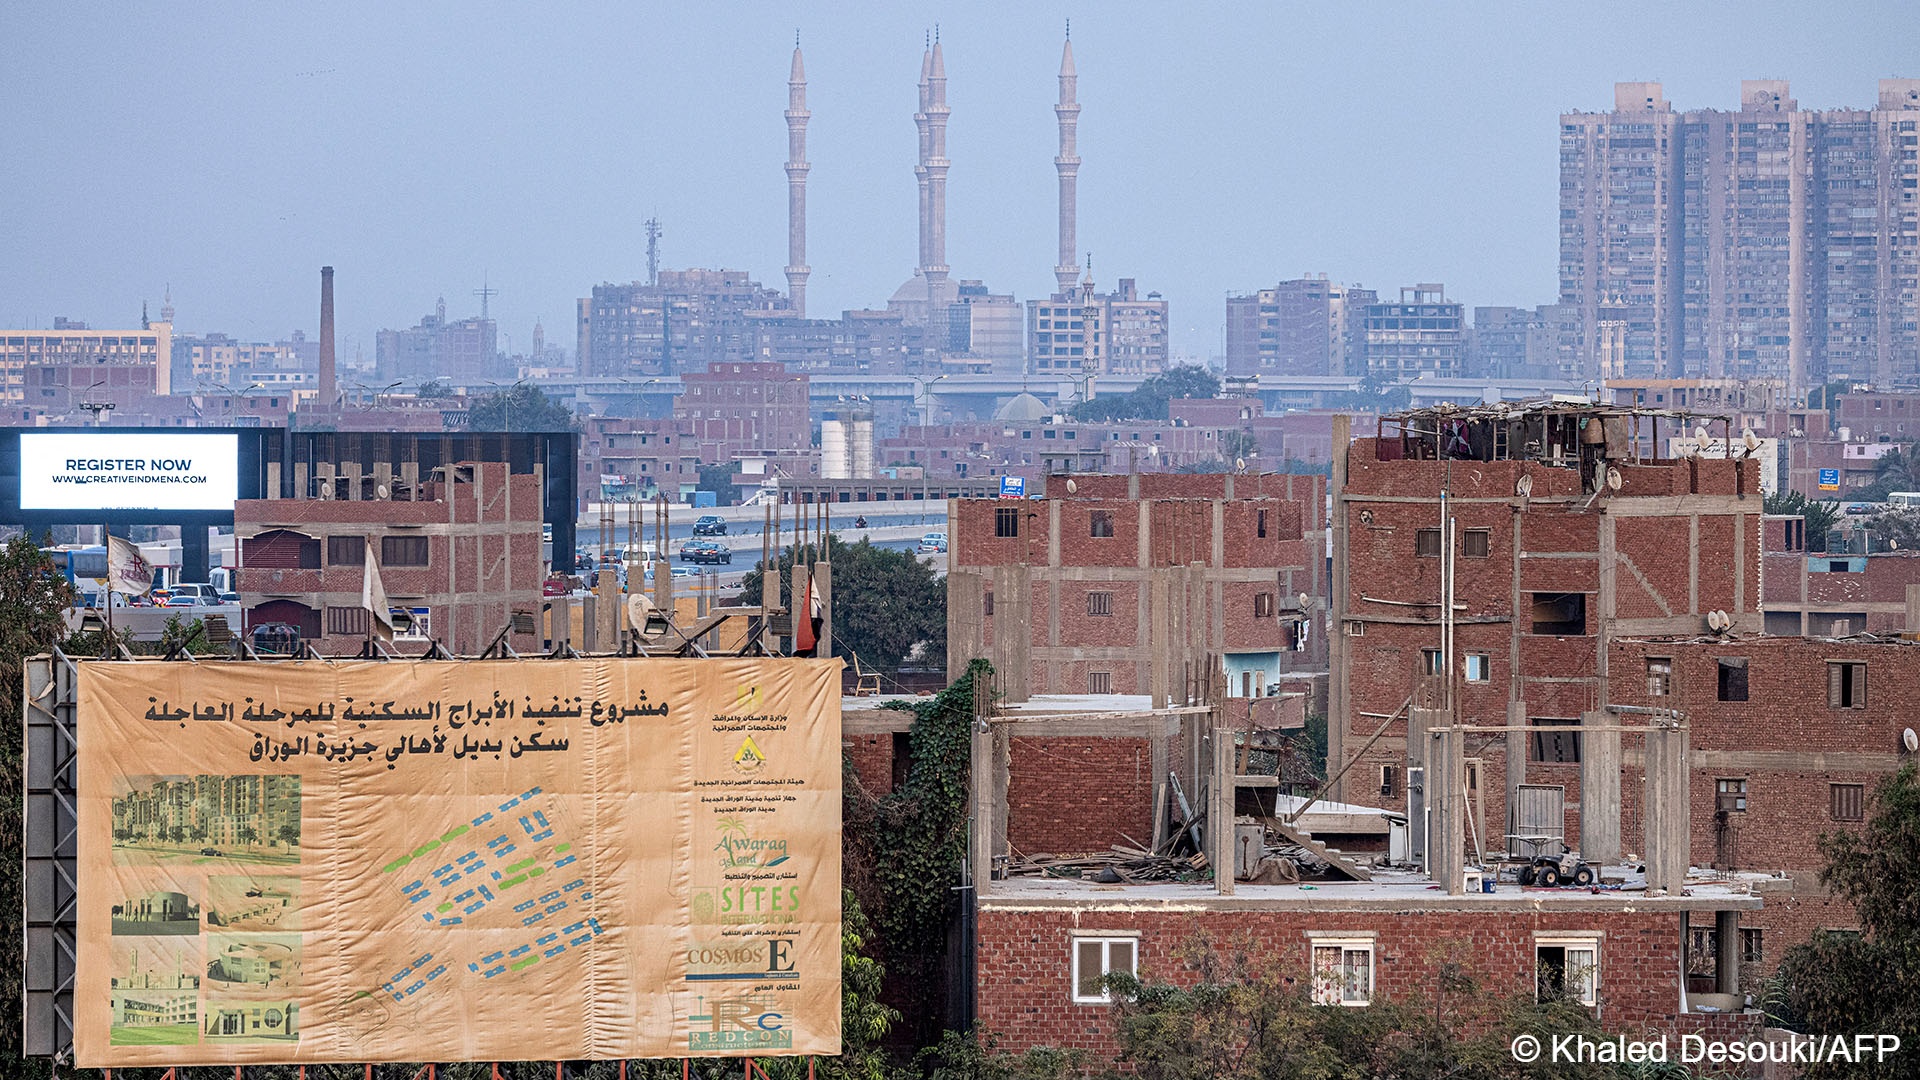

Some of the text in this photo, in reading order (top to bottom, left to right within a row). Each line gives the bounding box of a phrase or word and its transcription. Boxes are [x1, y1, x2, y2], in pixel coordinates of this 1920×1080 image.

[66, 459, 192, 471] REGISTER NOW
[52, 475, 207, 485] WWW.CREATIVEINDMENA.COM
[145, 690, 669, 729] مشروع تنفيذ الأبراج السكنية للمرحلة العاجلة
[711, 714, 788, 722] وزارة الإسكان والمرافق
[712, 724, 787, 732] والمجتمعات العمرانية
[249, 728, 569, 770] سكن بديل لأهالي جزيرة الوراق
[725, 873, 750, 881] والتخطيط
[751, 873, 775, 881] التصميم
[721, 885, 800, 912] SITES
[687, 939, 795, 972] COSMOS E
[754, 984, 800, 993] المقاول العام
[691, 1031, 790, 1043] REDCON
